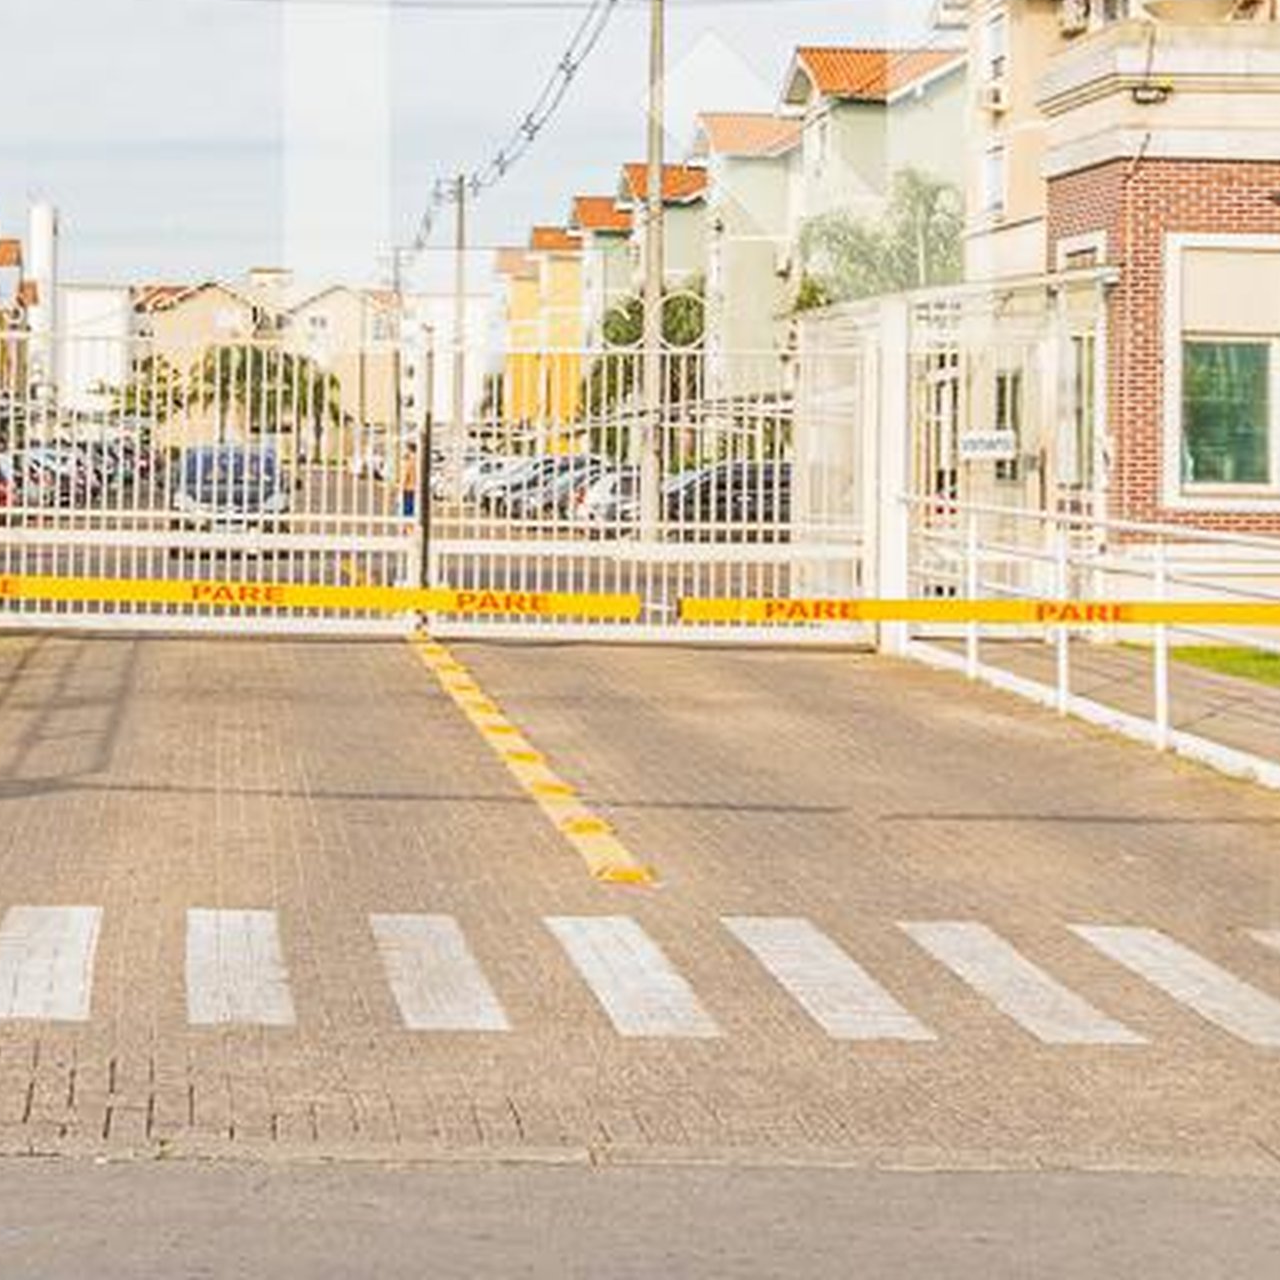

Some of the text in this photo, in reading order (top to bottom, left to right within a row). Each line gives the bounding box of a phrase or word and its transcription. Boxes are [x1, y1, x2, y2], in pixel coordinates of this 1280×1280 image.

[190, 584, 286, 605] PARE
[455, 592, 550, 613] PARE
[765, 600, 862, 620] PARE
[1035, 604, 1133, 623] PARE
